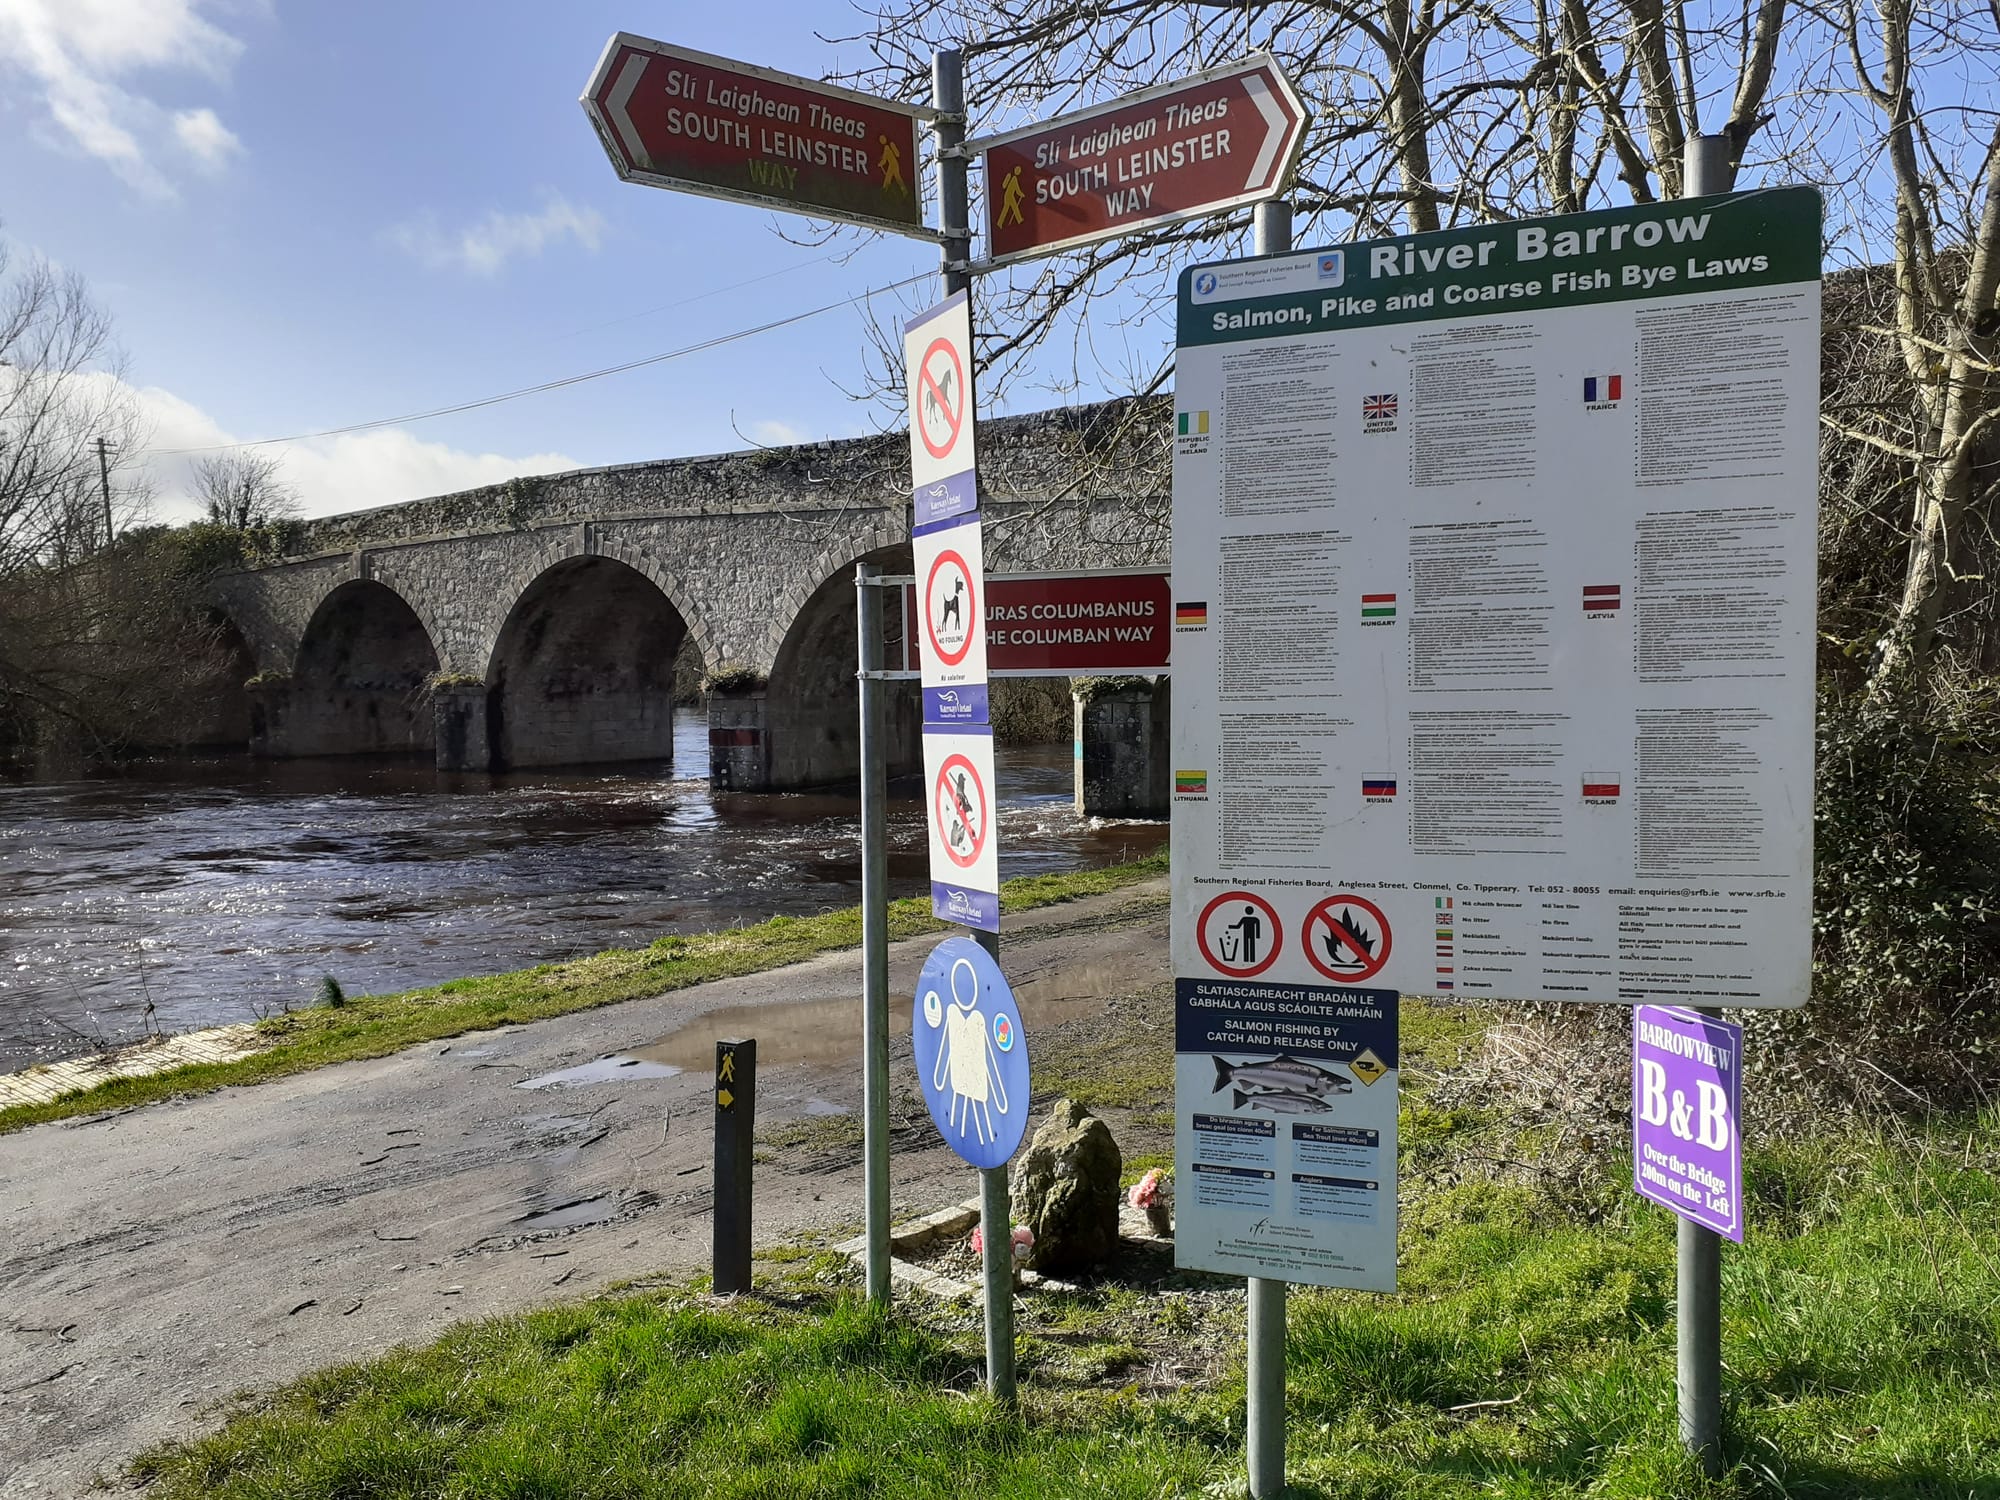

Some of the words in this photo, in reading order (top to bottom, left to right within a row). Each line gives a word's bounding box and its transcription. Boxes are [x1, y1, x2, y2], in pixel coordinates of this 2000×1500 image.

[665, 70, 696, 100] Slí
[706, 79, 799, 124] Laighean
[809, 104, 866, 139] Theas
[667, 108, 750, 149] SOUTH
[761, 128, 869, 175] LEINSTER
[1035, 140, 1061, 169] Slí
[1069, 117, 1157, 161] Laighean
[1165, 97, 1228, 130] Theas
[749, 158, 799, 191] WAY
[1036, 163, 1108, 204] SOUTH
[1118, 128, 1231, 180] LEINSTER
[1105, 183, 1154, 217] WAY
[1370, 240, 1497, 280] River
[1517, 213, 1711, 262] Barrow
[1213, 305, 1312, 331] Salmon,
[1321, 297, 1377, 318] Pike
[1385, 287, 1434, 310] and
[1444, 279, 1542, 304] Coarse
[1552, 269, 1611, 293] Fish
[1622, 264, 1677, 288] Bye
[1687, 255, 1769, 279] Laws
[1363, 426, 1398, 434] KINGDOM
[986, 605, 1027, 621] URAS
[1032, 601, 1154, 619] COLUMBANUS
[986, 630, 1006, 645] HE
[1010, 628, 1110, 644] COLUMBAN
[1115, 626, 1154, 641] WAY
[1194, 876, 1229, 884] Southern
[1232, 878, 1266, 886] Regional
[1306, 880, 1333, 888] Board,
[1338, 881, 1376, 890] Anglesea
[1379, 882, 1408, 890] Street,
[1413, 882, 1451, 891] Clonmel,
[1474, 884, 1520, 893] Tipperary.
[1528, 885, 1544, 893] Tel:
[1639, 888, 1720, 897] enquiries@srfb.ie
[1728, 890, 1786, 898] www.srfb.ie
[1189, 996, 1241, 1010] GABHÁLA
[1244, 1001, 1275, 1012] AGUS
[1278, 1002, 1333, 1016] SCÁOILTE
[1336, 1005, 1382, 1019] AMHÁIN
[1197, 985, 1305, 1001] SLATIASCAIREACHT
[1309, 990, 1356, 1005] BRADÁN
[1360, 995, 1374, 1005] LE
[1207, 1032, 1243, 1043] CATCH
[1247, 1034, 1270, 1045] AND
[1274, 1036, 1324, 1049] RELEASE
[1328, 1040, 1358, 1051] ONLY
[1225, 1020, 1272, 1033] SALMON
[1275, 1023, 1320, 1036] FISHING
[1324, 1026, 1339, 1036] BY
[1640, 1020, 1731, 1072] BARROWVIEW
[1640, 1058, 1728, 1152] B&B
[1641, 1162, 1666, 1186] 200m
[1668, 1179, 1681, 1196] on
[1683, 1181, 1701, 1204] the
[1705, 1191, 1730, 1217] Left
[1644, 1143, 1668, 1168] Over
[1669, 1155, 1685, 1176] the
[1688, 1162, 1726, 1196] Bridge
